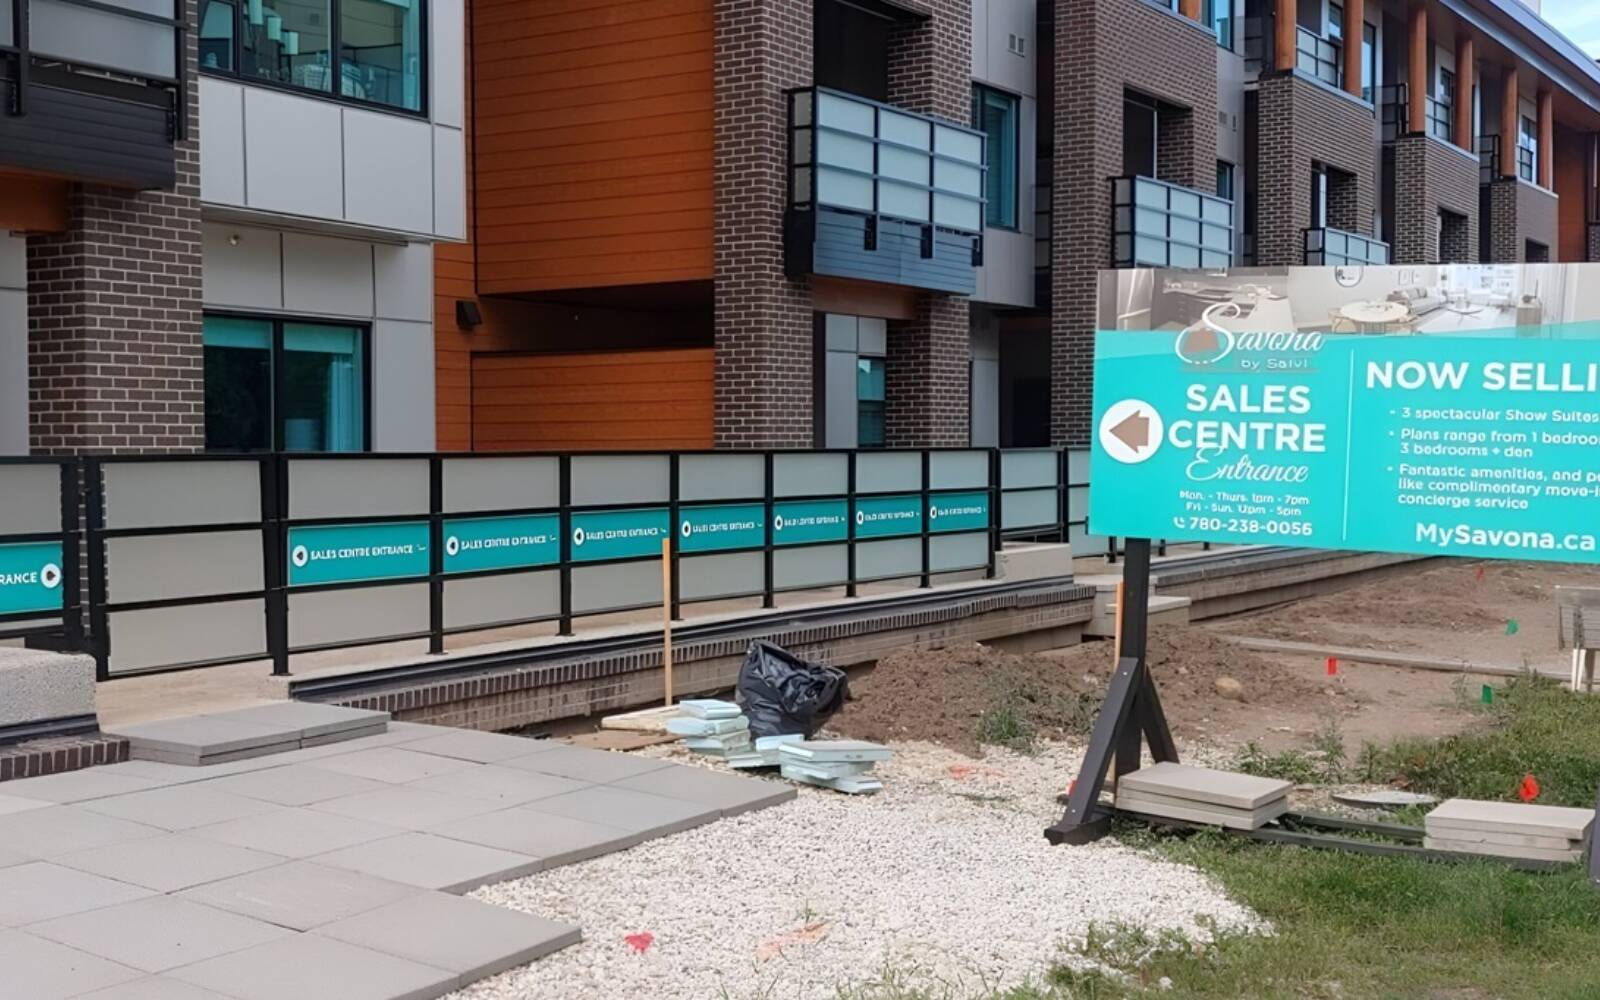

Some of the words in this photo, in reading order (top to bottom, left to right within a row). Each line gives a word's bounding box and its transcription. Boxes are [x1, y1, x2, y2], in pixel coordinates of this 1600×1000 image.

[1175, 302, 1324, 364] Savona
[1240, 358, 1260, 369] by
[1267, 358, 1307, 368] Salvi
[1366, 360, 1469, 390] NOW
[1482, 361, 1598, 392] SELLI
[1186, 384, 1311, 414] SALES
[1402, 407, 1411, 418] 3
[1415, 408, 1500, 421] spectacular
[1505, 409, 1547, 421] Show
[1168, 420, 1326, 452] CENTRE
[1401, 428, 1439, 440] Plans
[1443, 431, 1486, 443] range
[1491, 431, 1527, 443] from
[1532, 432, 1538, 443] 1
[1542, 432, 1600, 445] bedroo
[1400, 442, 1409, 454] 3
[1413, 443, 1488, 456] bedrooms
[1504, 446, 1533, 458] den
[1186, 446, 1309, 482] Entrance
[1399, 463, 1466, 477] Fantastic
[1471, 467, 1548, 481] amenities,
[1552, 469, 1582, 481] and
[1398, 478, 1424, 490] like
[1428, 480, 1541, 497] complimentary
[1545, 485, 1600, 497] move-i
[1285, 495, 1309, 505] 7pm
[1398, 494, 1470, 508] concierge
[1474, 496, 1528, 509] service
[1276, 506, 1302, 516] 5pm
[1189, 517, 1313, 536] 780-238-0056
[1415, 522, 1597, 551] MySavona.ca
